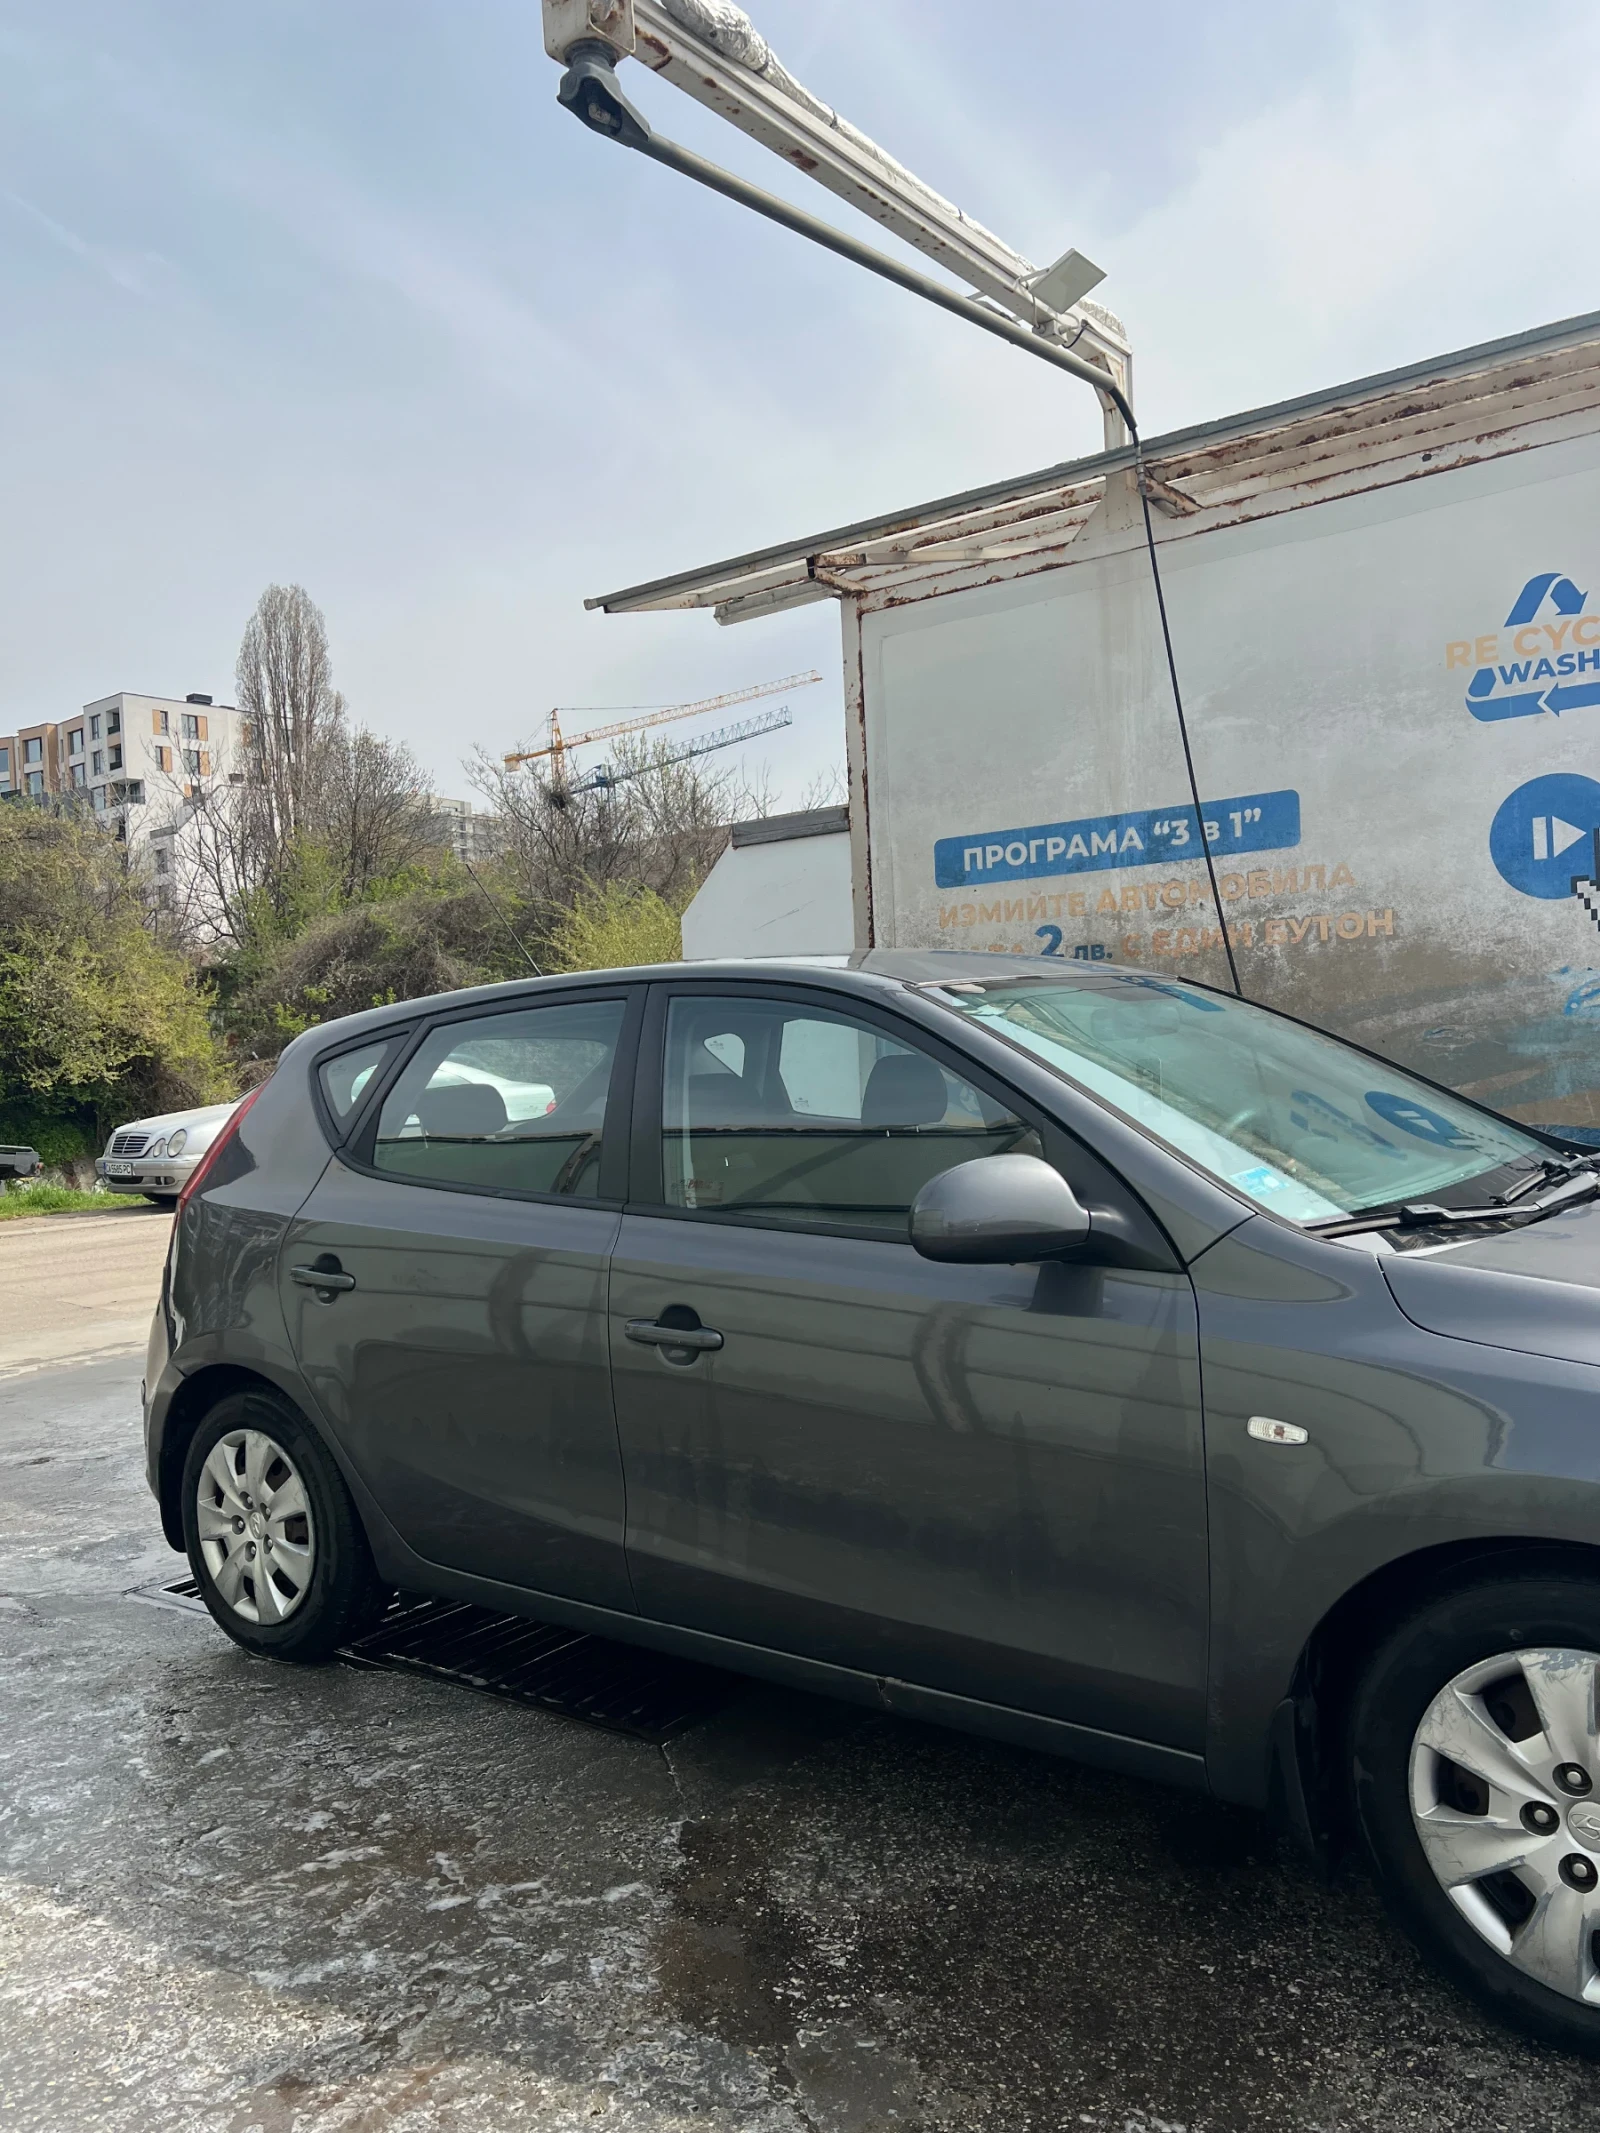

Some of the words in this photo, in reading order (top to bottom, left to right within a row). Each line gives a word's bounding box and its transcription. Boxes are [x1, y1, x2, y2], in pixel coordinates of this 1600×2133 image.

[1445, 634, 1499, 670] RE
[1498, 649, 1600, 685] WASH
[963, 826, 1144, 872] ПРОГРАМА
[1203, 821, 1220, 842] в
[938, 890, 1087, 929] ИЗМИЙТЕ
[1096, 862, 1356, 913] АВТОМОБИЛА
[1034, 924, 1064, 957] 2
[1120, 933, 1143, 959] С
[1264, 908, 1394, 946] БУТОН
